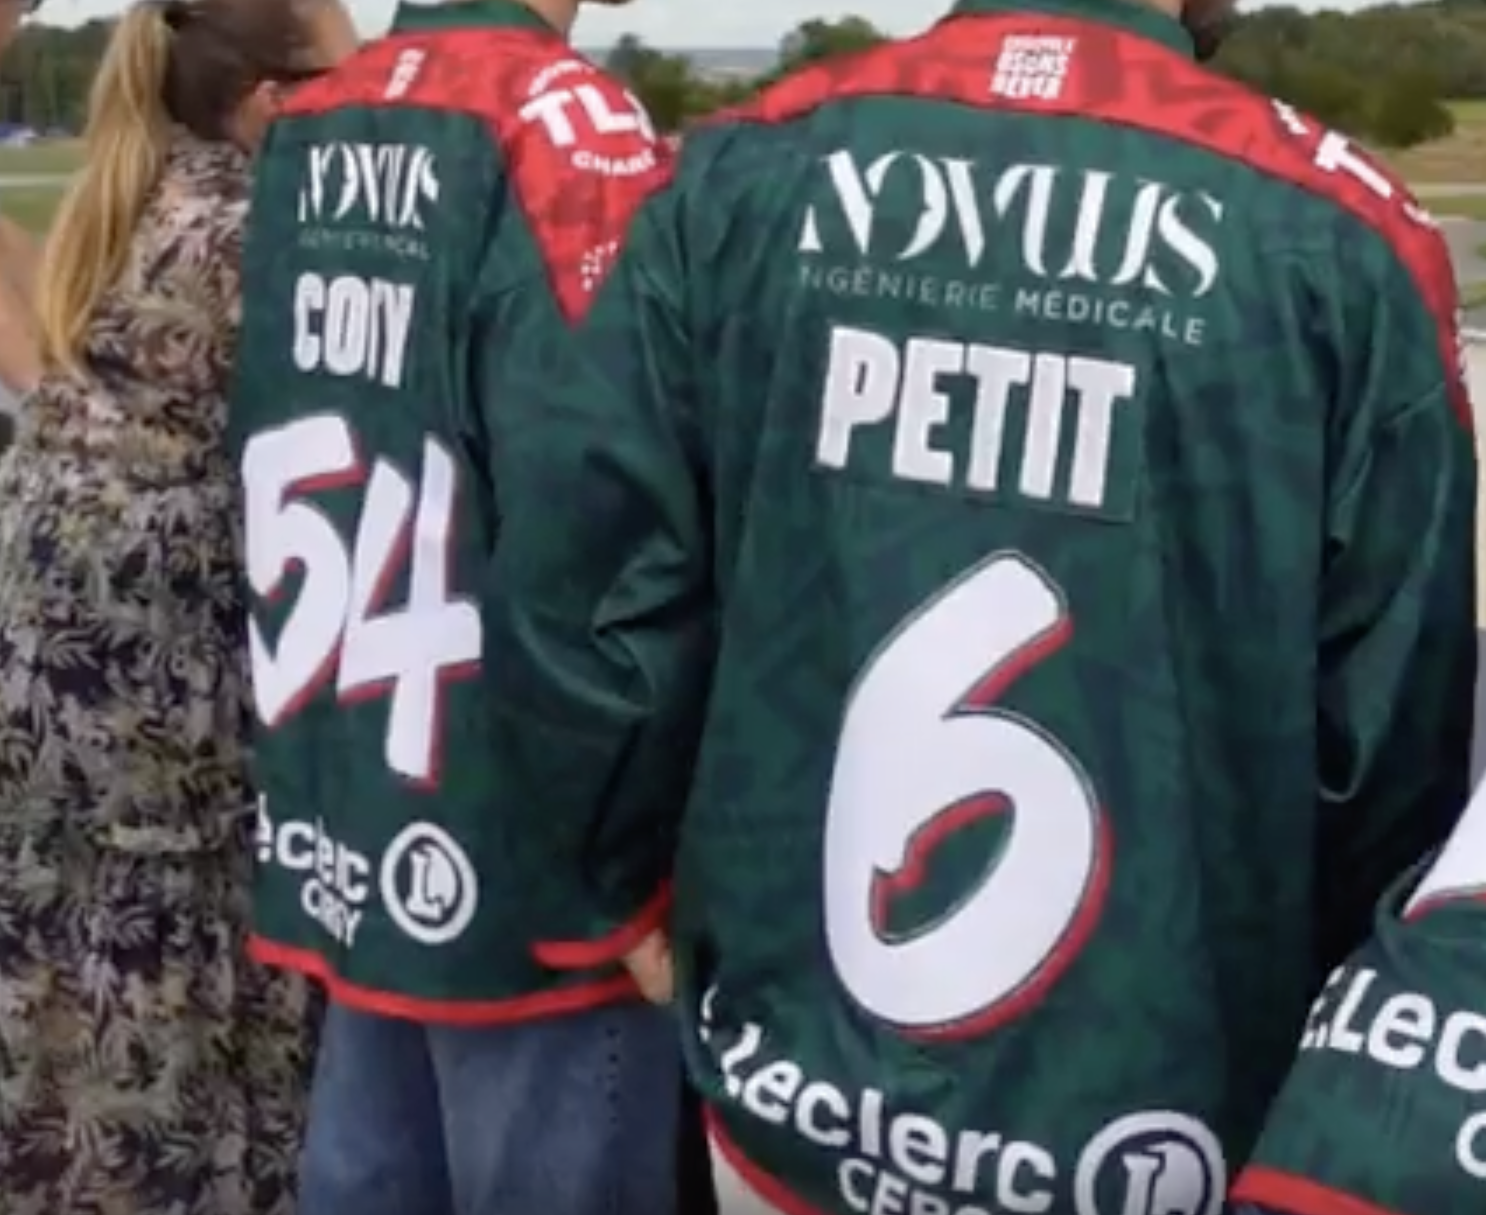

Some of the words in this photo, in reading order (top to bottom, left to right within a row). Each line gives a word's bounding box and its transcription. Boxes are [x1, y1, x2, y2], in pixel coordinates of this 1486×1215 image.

[797, 148, 1224, 298] NOVUS
[798, 263, 1002, 311] NGÉNIERIE
[816, 326, 1135, 507] PETIT
[241, 415, 484, 793] 54
[823, 549, 1111, 1042] 6
